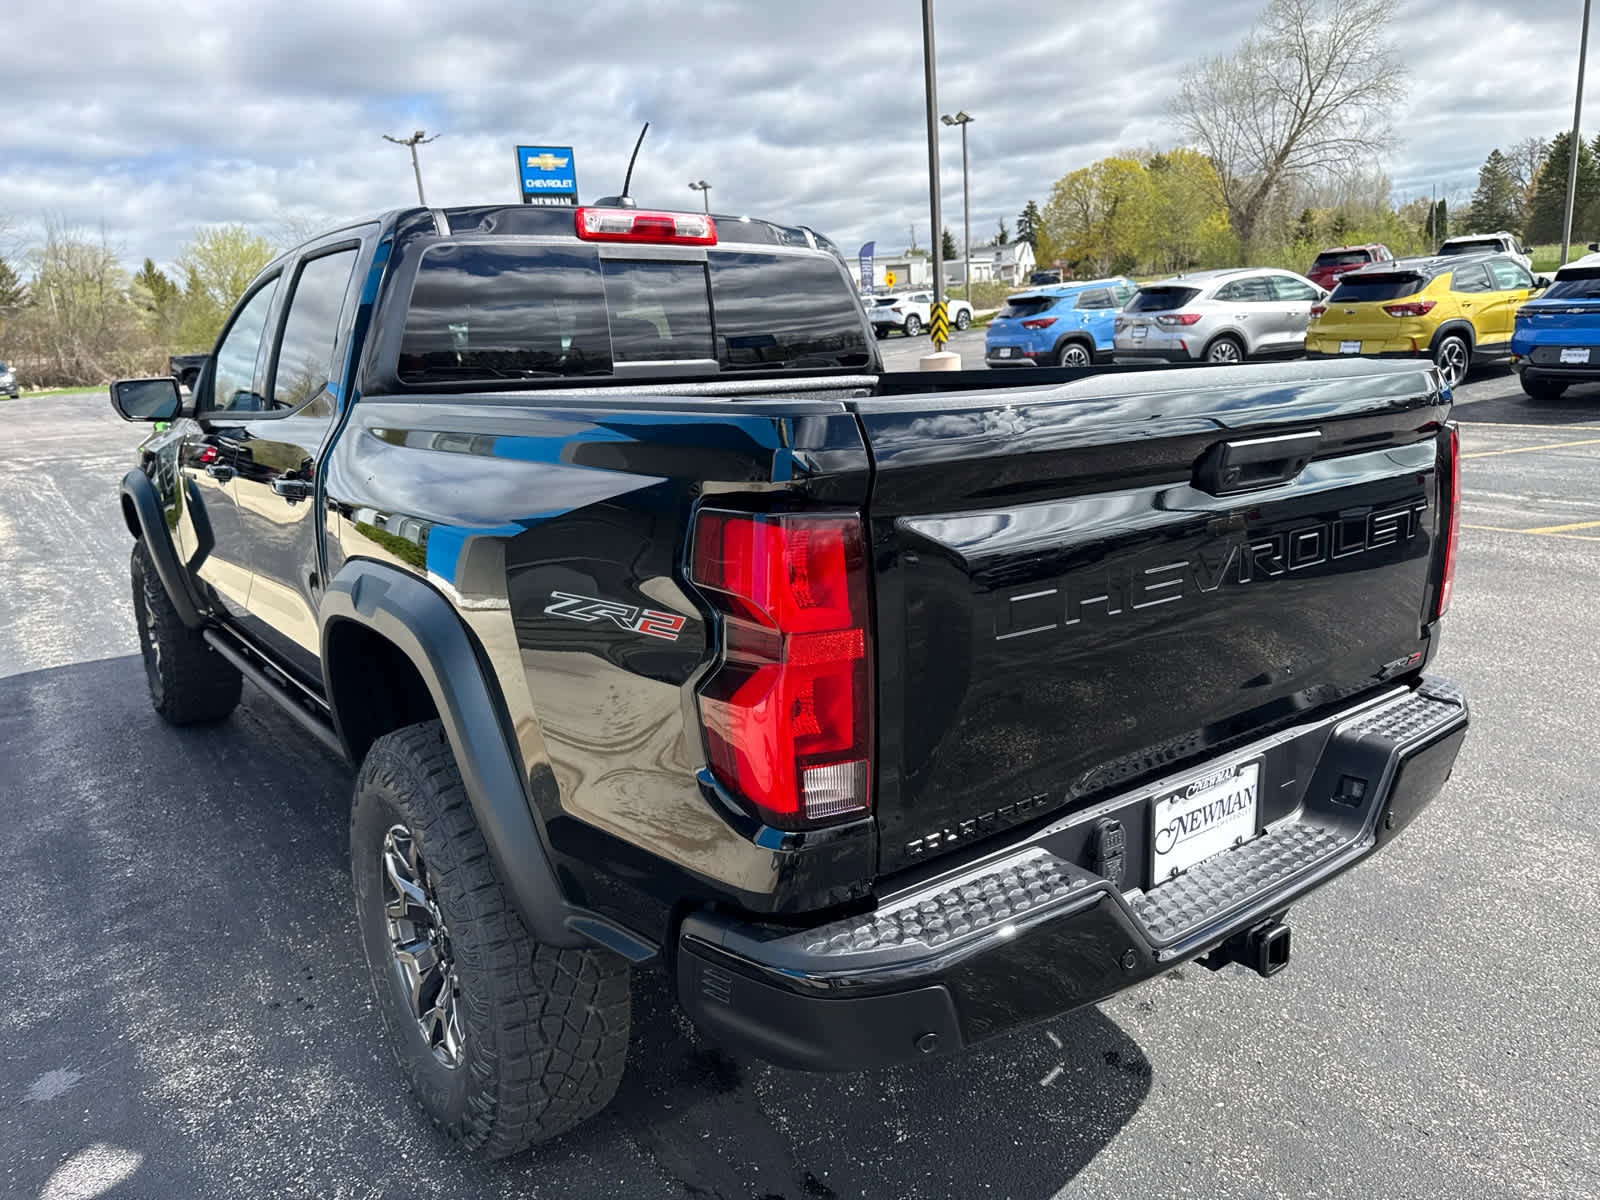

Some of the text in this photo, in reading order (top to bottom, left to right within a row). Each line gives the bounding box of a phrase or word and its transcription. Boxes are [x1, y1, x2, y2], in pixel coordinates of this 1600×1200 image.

[525, 179, 573, 188] CHEVROLET
[531, 196, 572, 205] NEWMAN
[994, 503, 1428, 640] CHEVROLET
[543, 590, 687, 641] ZR2
[1154, 784, 1256, 855] NEWMAN
